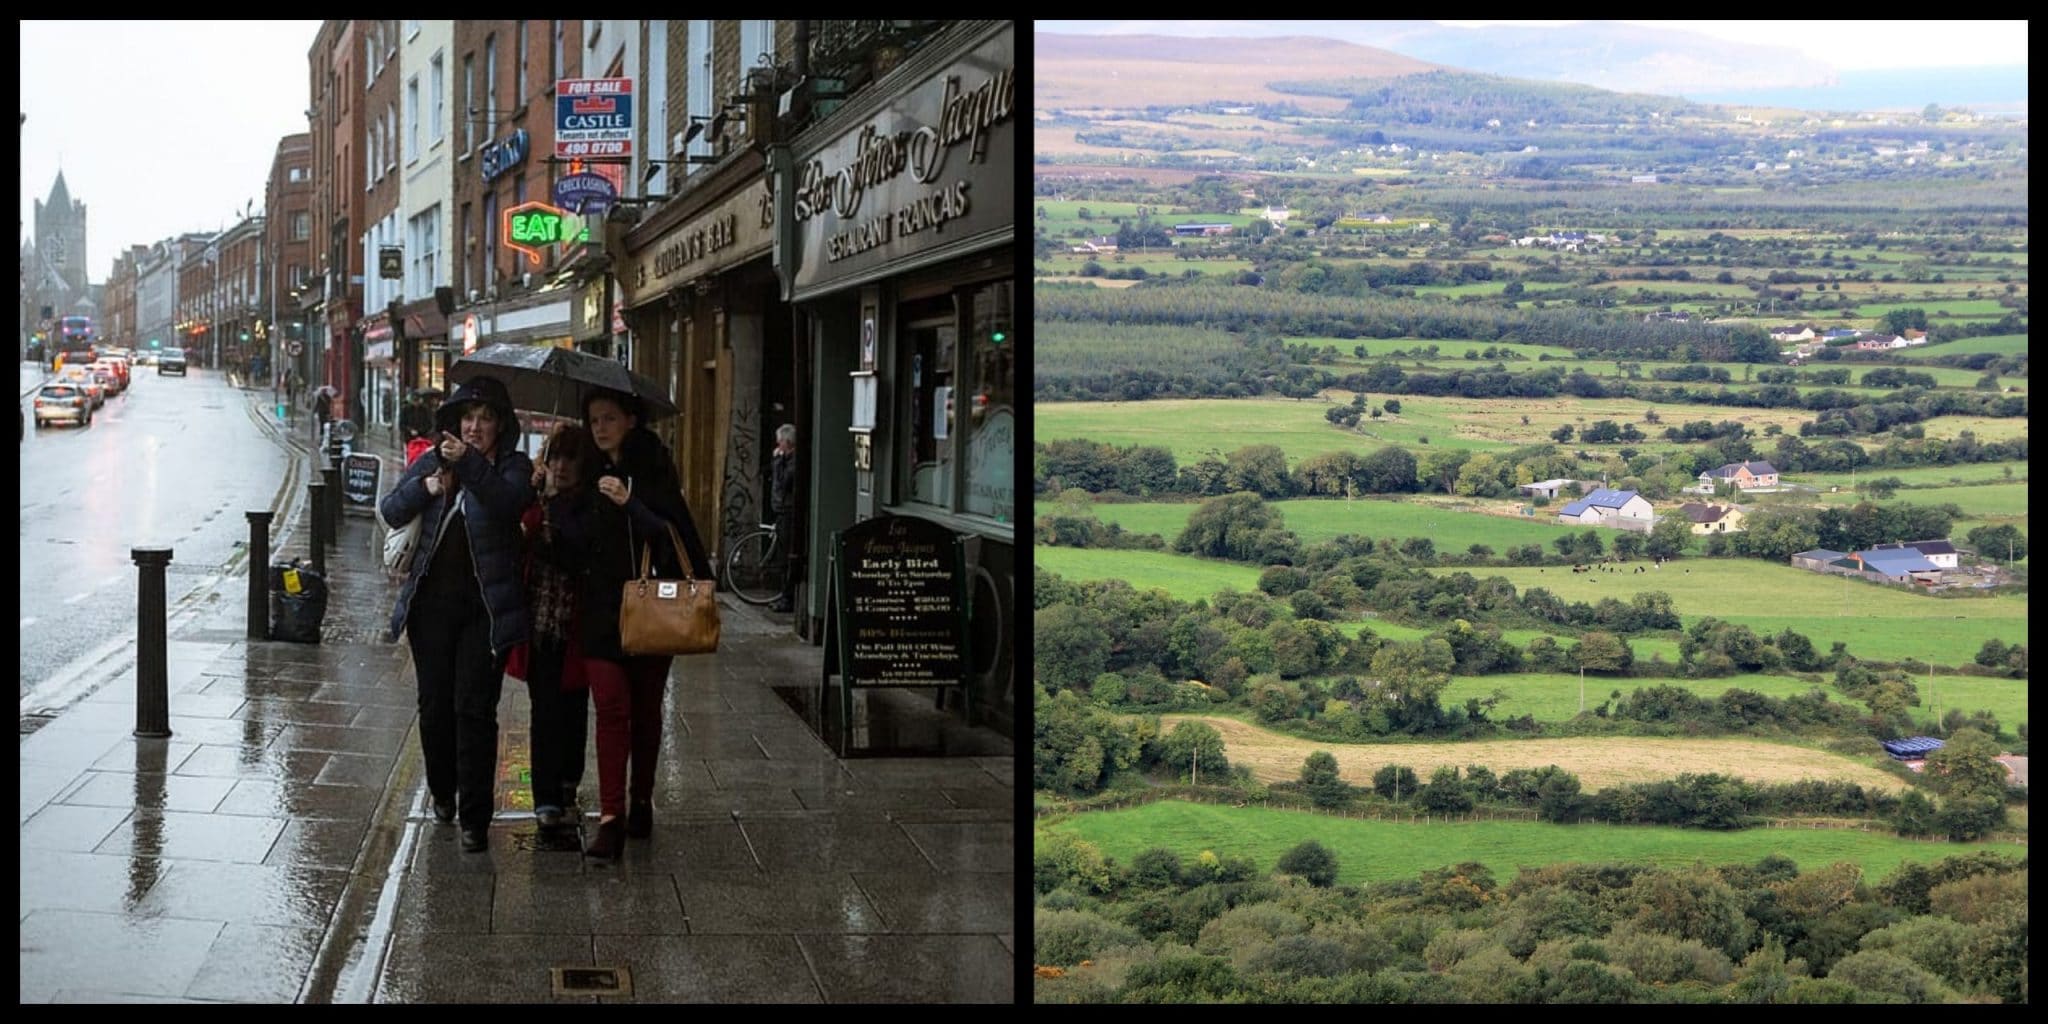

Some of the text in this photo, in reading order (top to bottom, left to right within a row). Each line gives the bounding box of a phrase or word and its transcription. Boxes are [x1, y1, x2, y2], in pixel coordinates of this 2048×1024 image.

[568, 82, 621, 94] FOR SALE
[565, 114, 624, 128] CASTLE
[564, 142, 623, 155] 490 0700
[512, 213, 559, 241] EAT
[827, 181, 969, 262] RESTAURANT FRANÇAIS
[863, 559, 939, 570] Early Bird
[852, 571, 891, 580] Monday
[909, 570, 952, 580] Saturday
